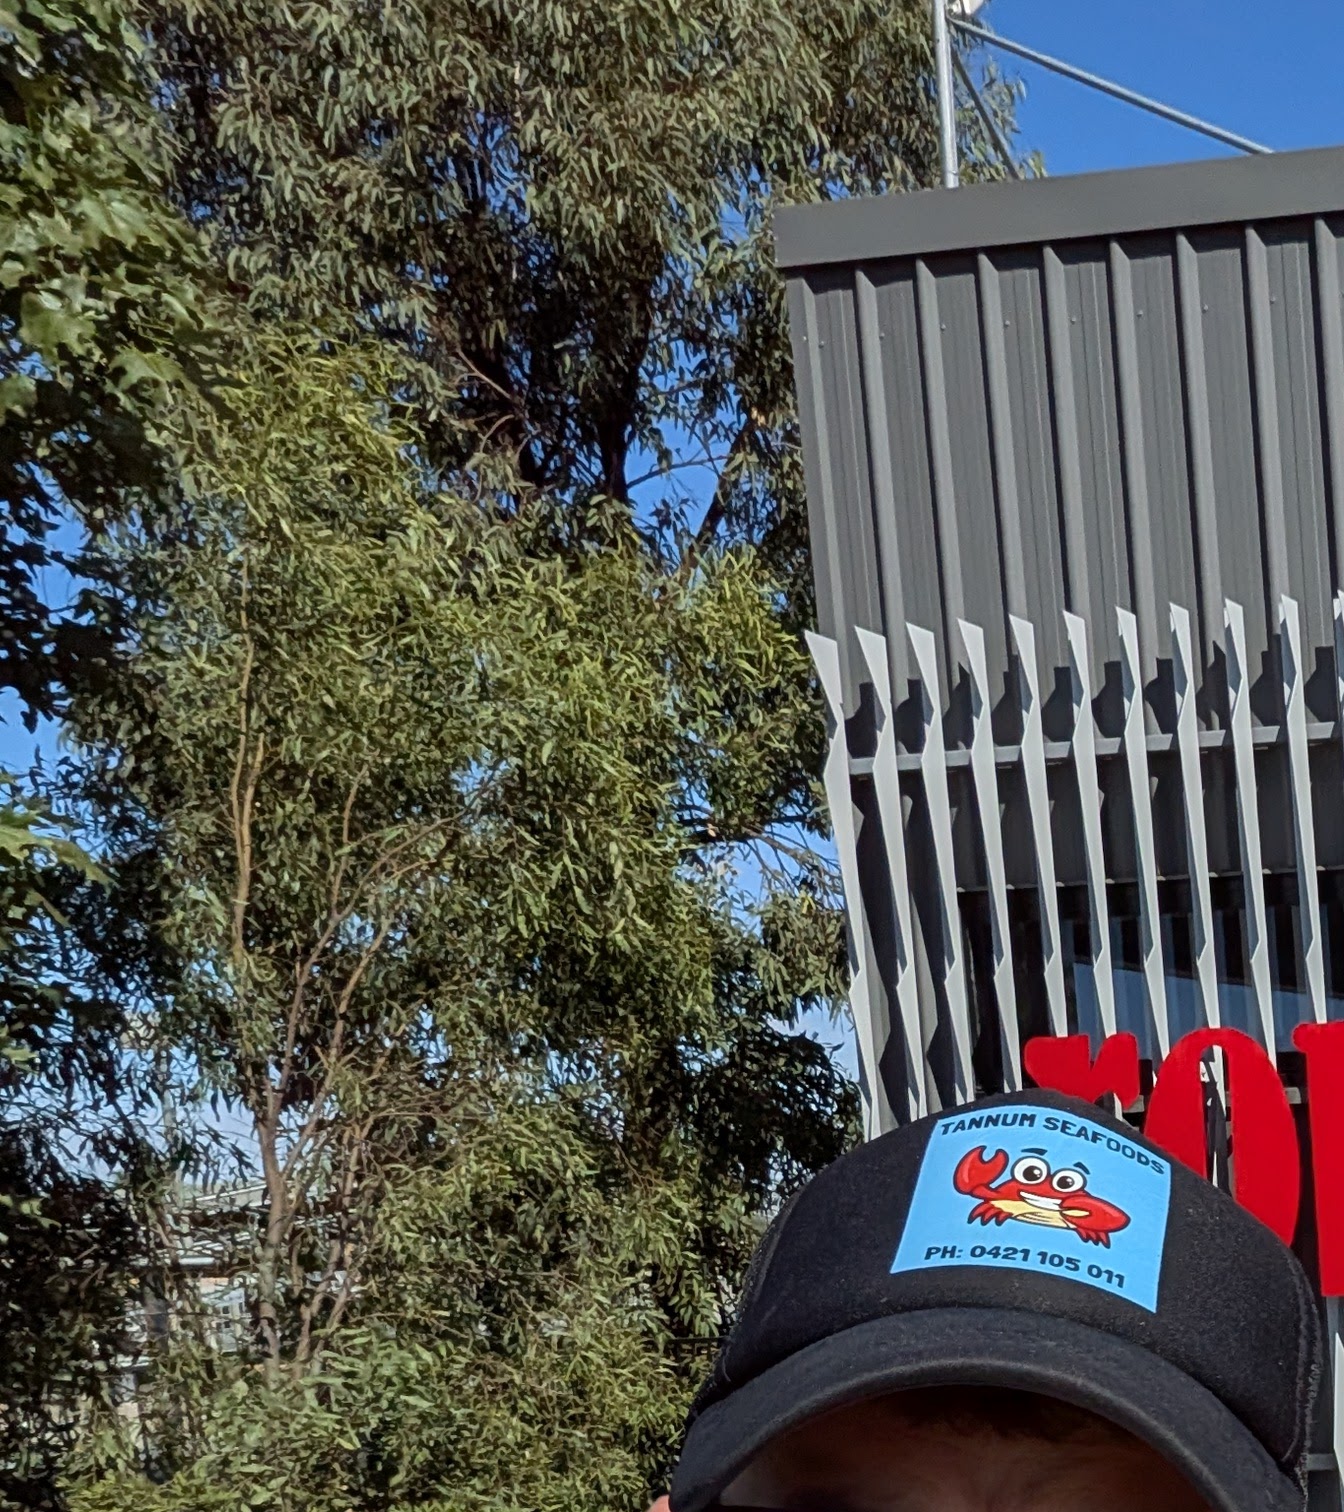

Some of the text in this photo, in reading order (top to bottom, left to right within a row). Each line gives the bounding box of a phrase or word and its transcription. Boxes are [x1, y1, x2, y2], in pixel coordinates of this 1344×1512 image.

[940, 1113, 1165, 1175] TANNUM SEAFOODS
[924, 1244, 1126, 1289] PH: 0421 105 011
